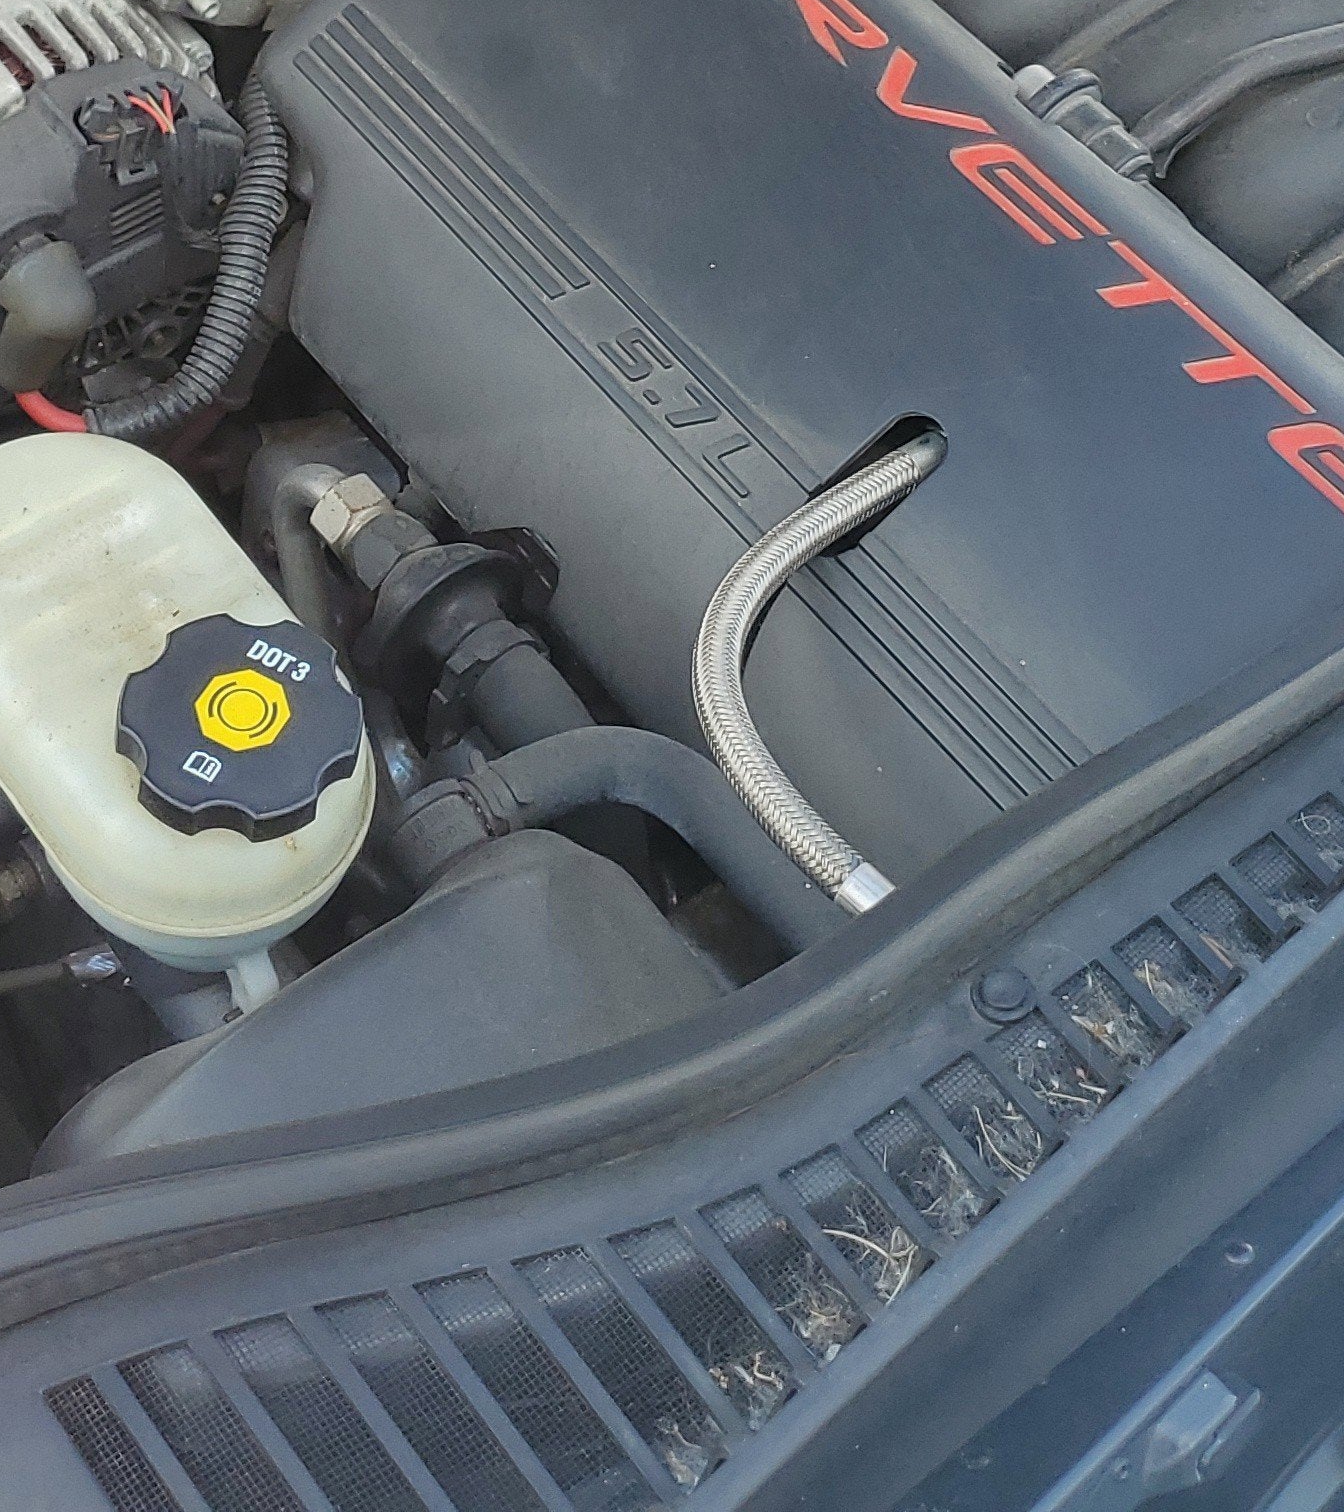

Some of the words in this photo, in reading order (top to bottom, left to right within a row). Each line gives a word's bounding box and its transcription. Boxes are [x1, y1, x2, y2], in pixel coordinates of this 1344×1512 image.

[597, 326, 751, 499] 5.7L
[246, 639, 297, 673] DOT
[290, 661, 311, 681] 3
